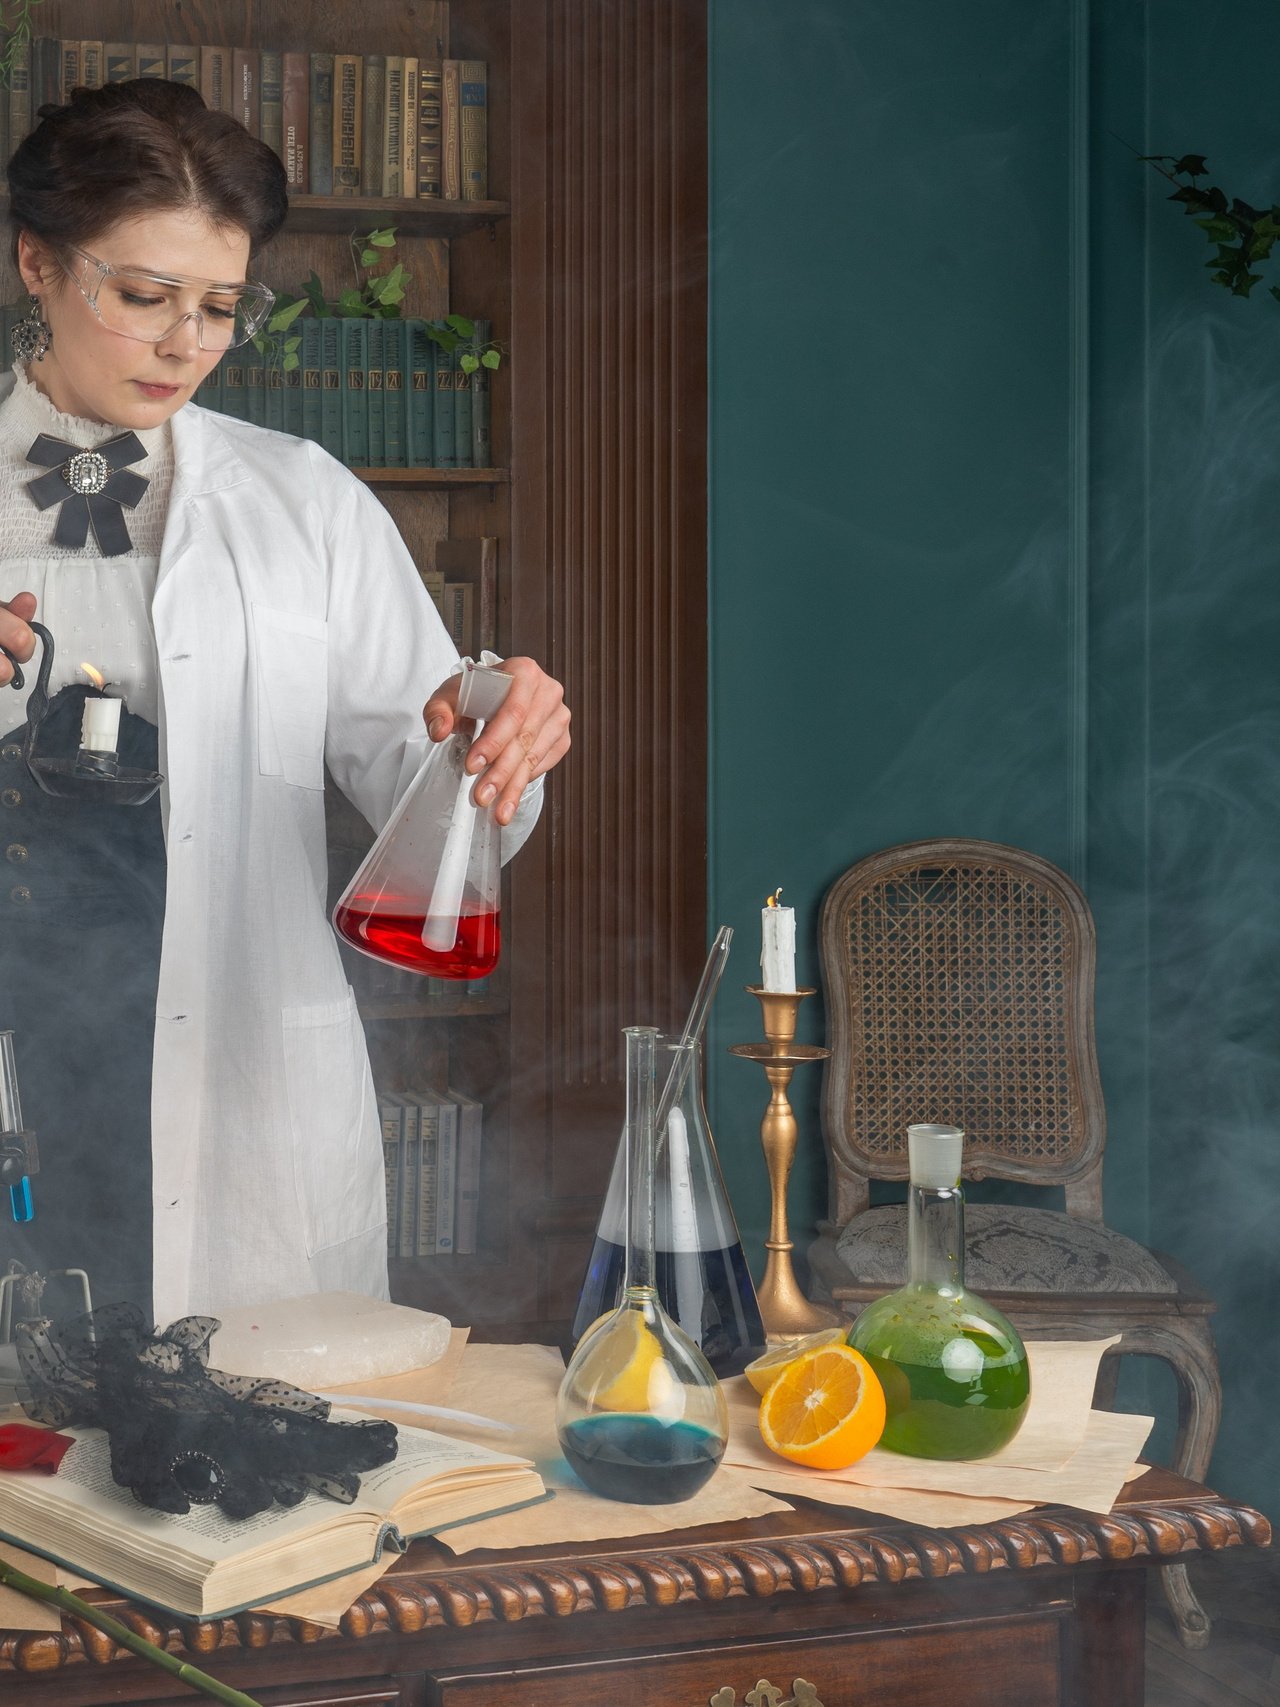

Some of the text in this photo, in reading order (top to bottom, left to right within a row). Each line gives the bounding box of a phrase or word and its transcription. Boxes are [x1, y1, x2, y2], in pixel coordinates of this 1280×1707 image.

[334, 63, 359, 187] СТЕНДАЛЬ
[287, 126, 296, 183] ОТЕЦ ИАКИНФ
[230, 369, 241, 385] 12
[307, 371, 318, 387] 16
[326, 371, 337, 388] 17
[350, 371, 361, 387] 18
[371, 371, 382, 388] 19
[388, 372, 400, 389] 20
[415, 373, 426, 388] 21
[438, 372, 451, 388] 22
[458, 372, 470, 388] 23
